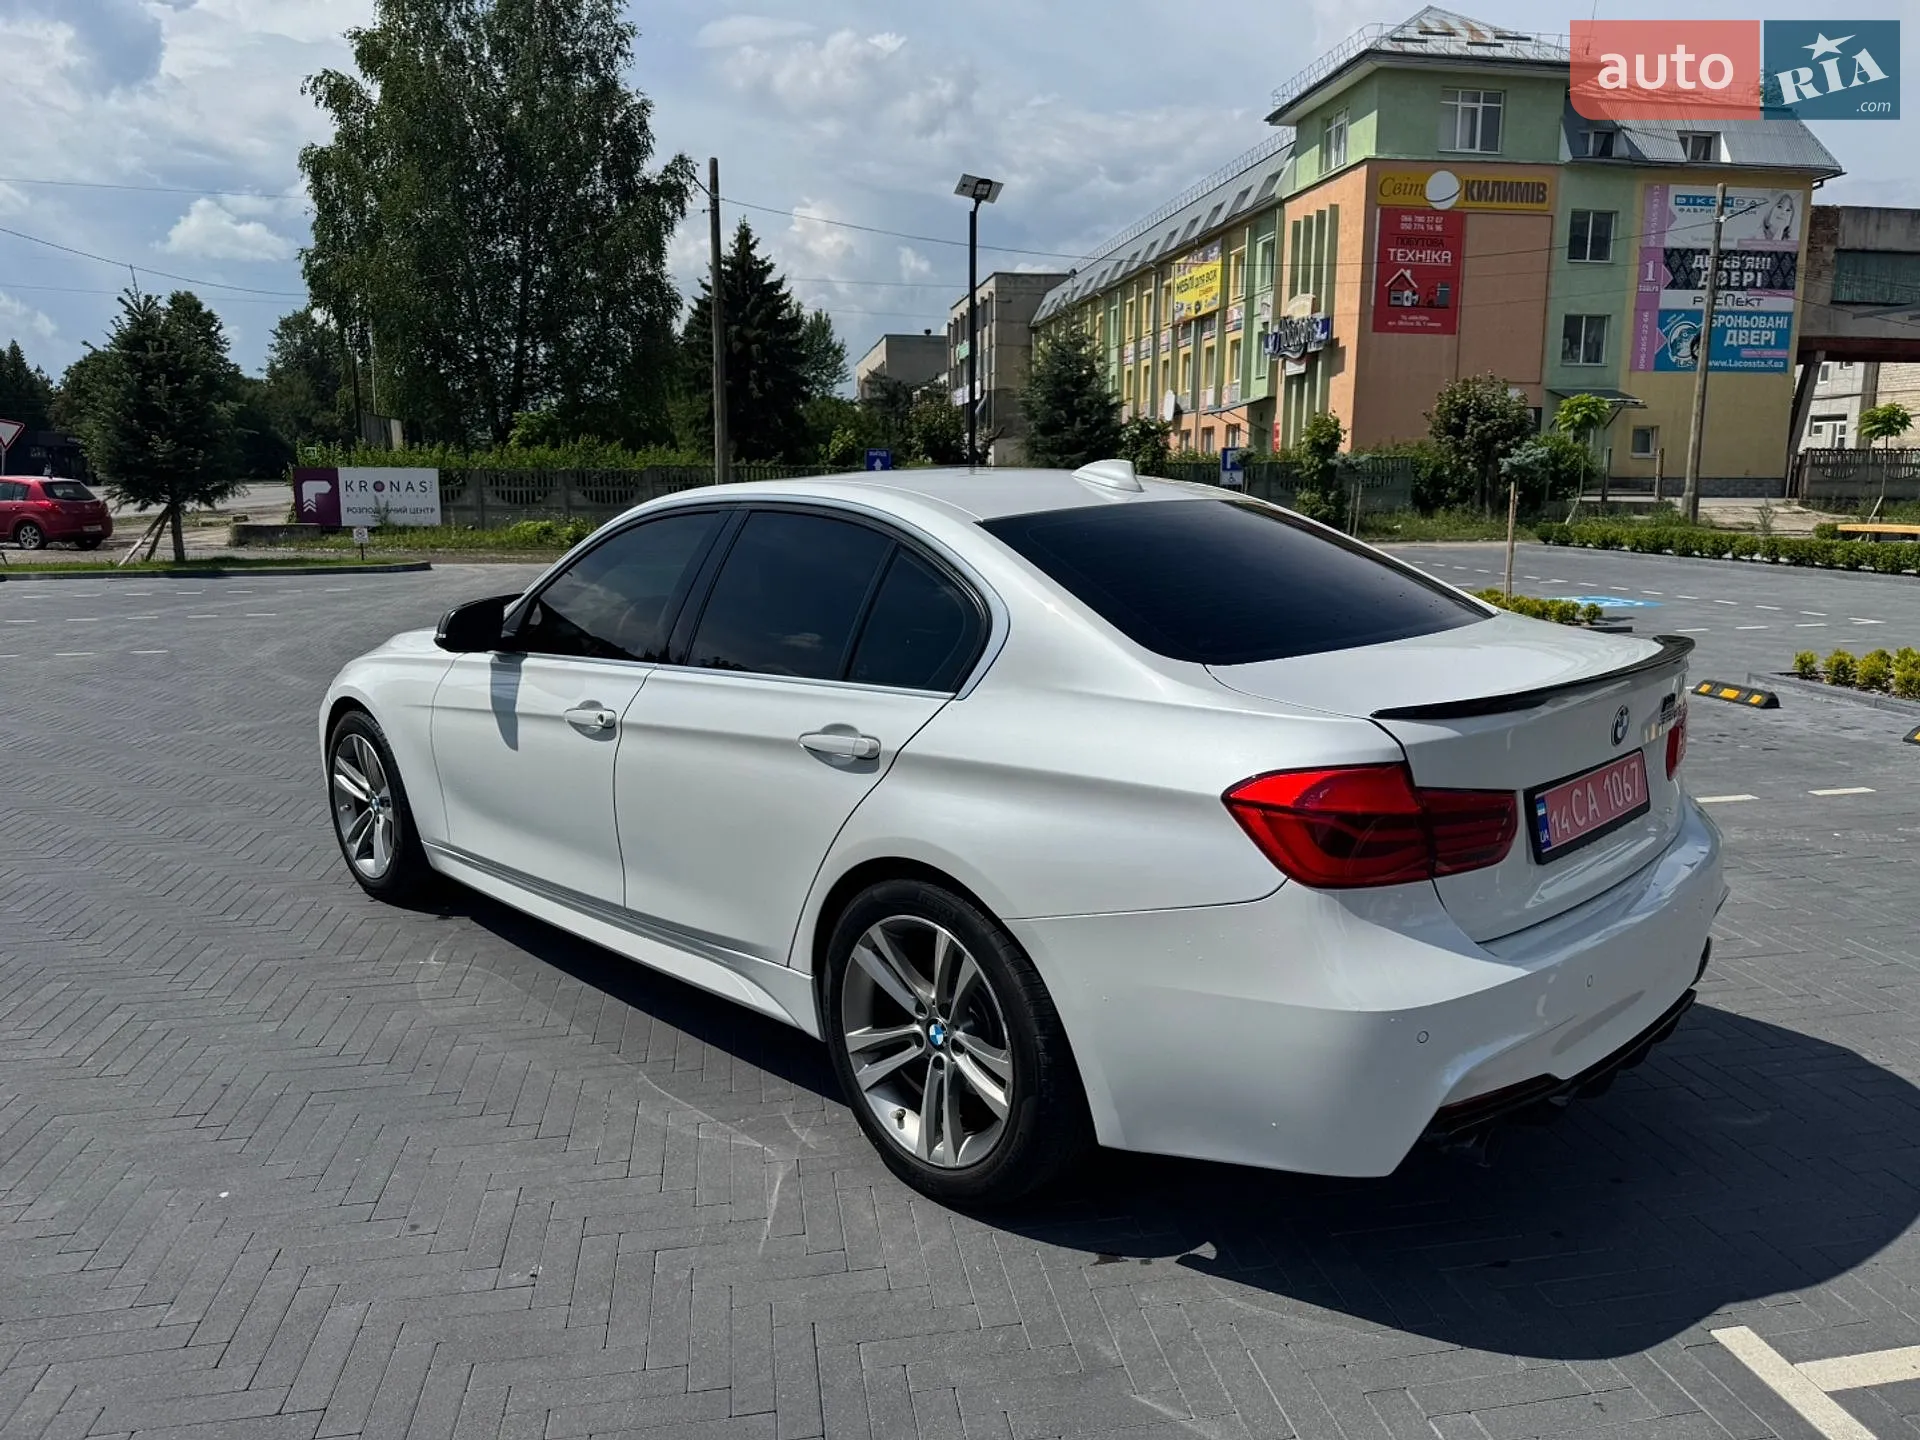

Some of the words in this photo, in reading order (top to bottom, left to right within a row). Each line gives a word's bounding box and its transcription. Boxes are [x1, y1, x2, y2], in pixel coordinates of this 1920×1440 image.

[1464, 179, 1548, 204] КИЛИМІВ
[1387, 247, 1452, 263] ТЕХНІКА
[1692, 254, 1771, 270] ДЕЕВ'ЯНІ
[1643, 259, 1656, 281] 1
[1692, 293, 1764, 307] РСПЕКТ
[1711, 314, 1788, 329] БРОНЬОВАНІ
[1724, 329, 1776, 347] ДВЕРІ
[345, 480, 428, 493] KRONAS
[409, 506, 436, 515] ЦЕНТР
[1551, 805, 1570, 838] 14
[1571, 781, 1600, 829] CA
[1603, 762, 1639, 811] 1067
